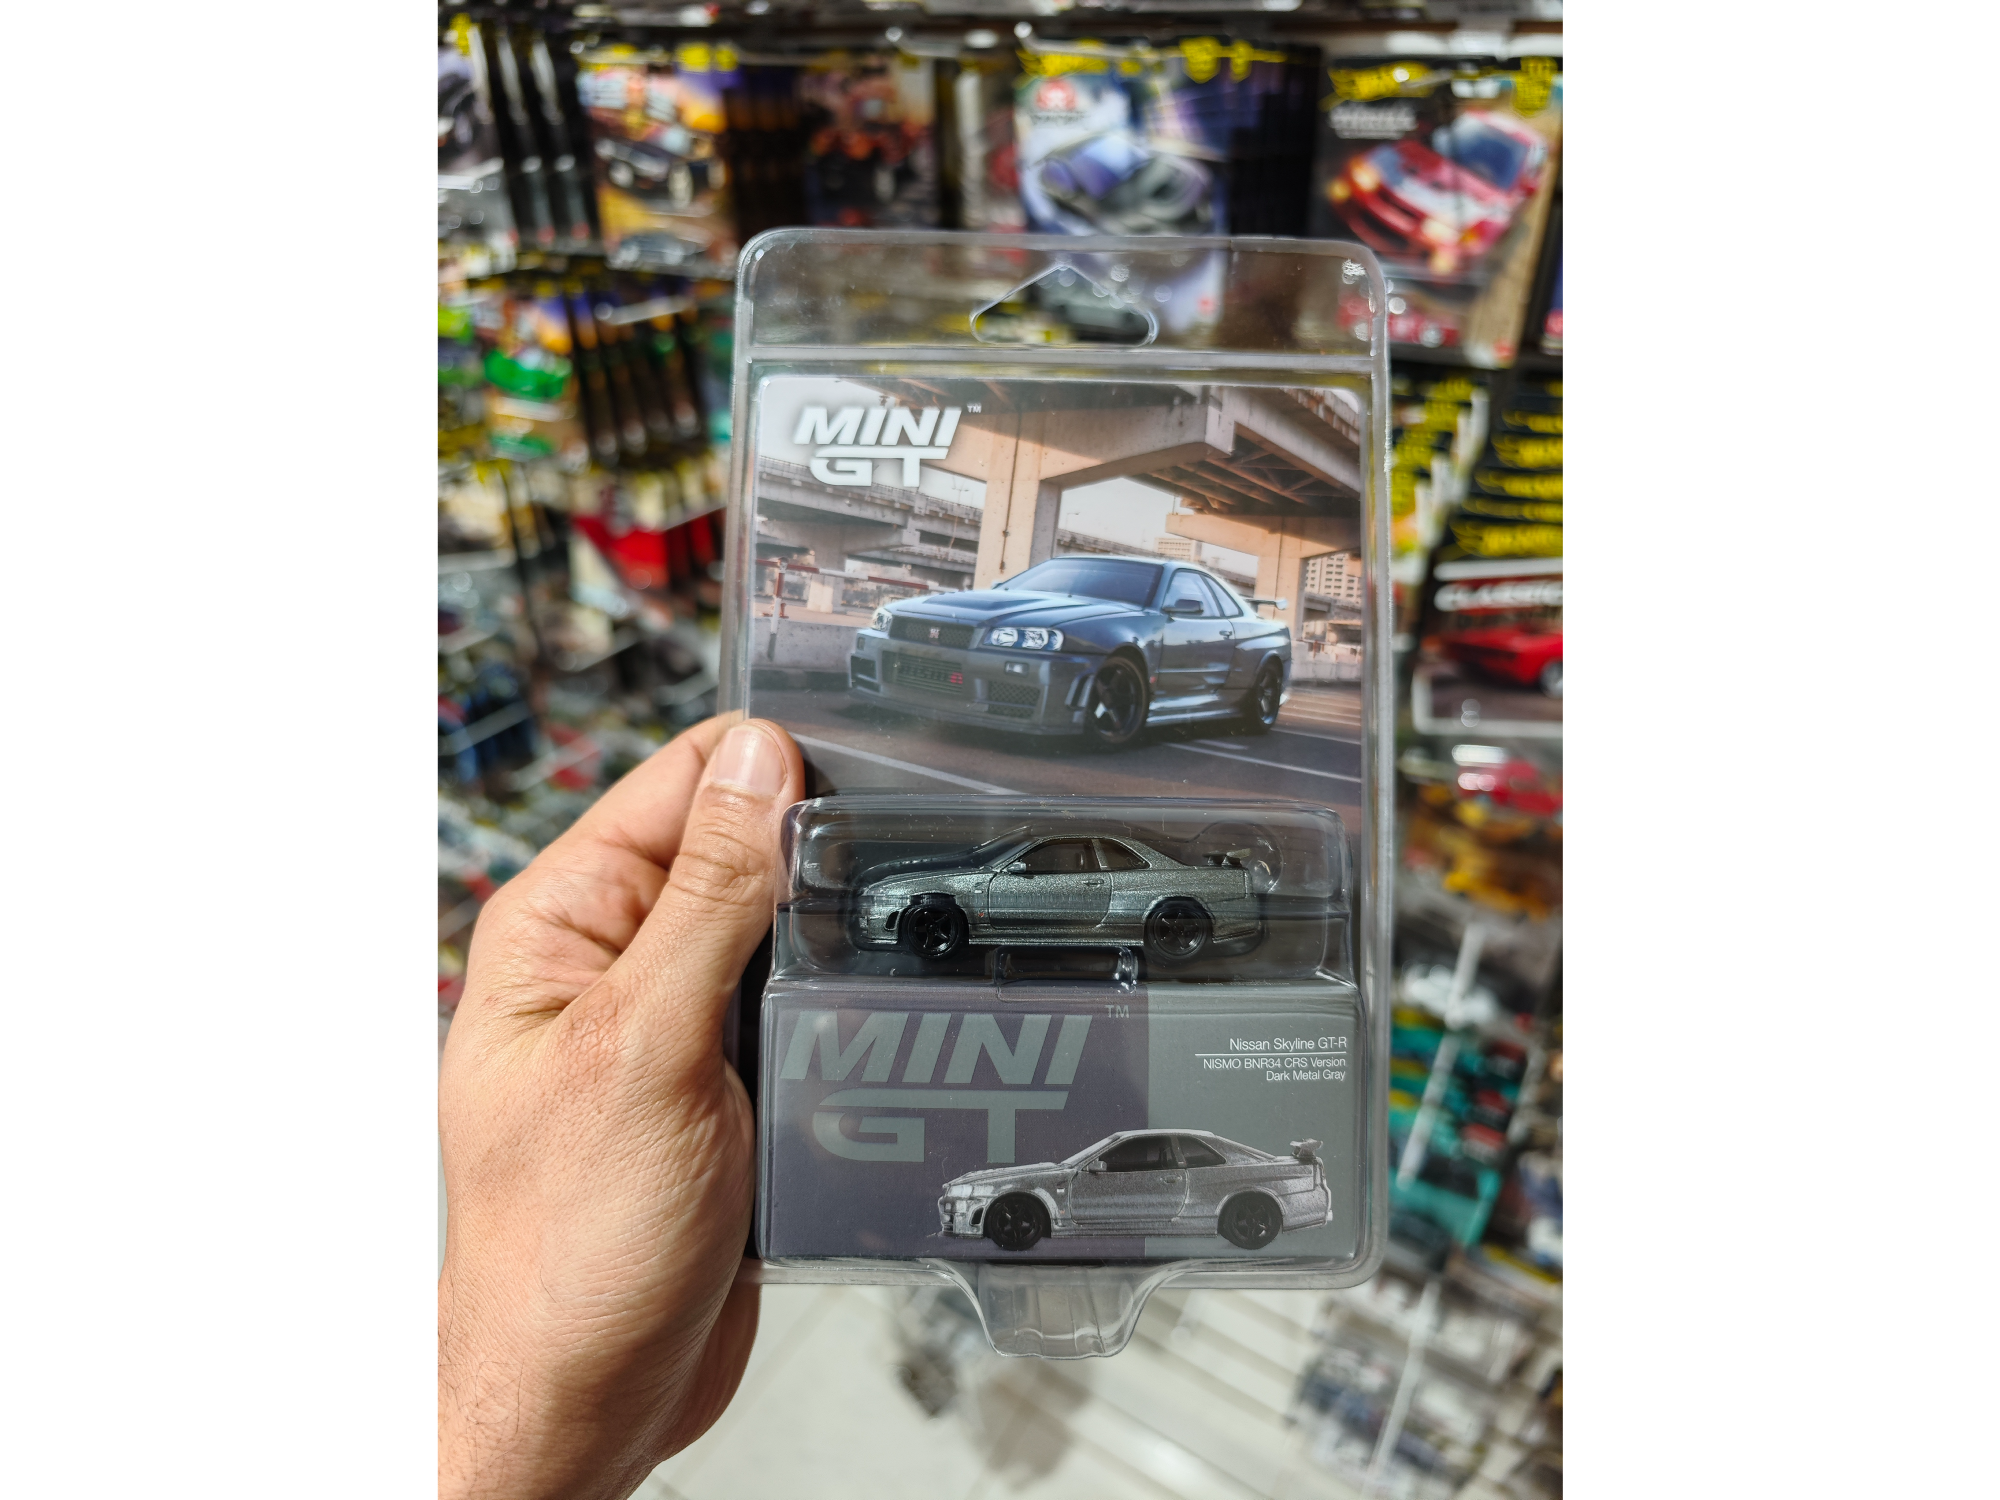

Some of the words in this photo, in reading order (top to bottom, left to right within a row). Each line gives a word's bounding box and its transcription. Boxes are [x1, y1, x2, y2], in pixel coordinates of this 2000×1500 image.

[794, 406, 962, 447] MINI
[809, 446, 949, 488] GT
[779, 1010, 1093, 1085] MINI
[1203, 1058, 1241, 1069] NISMO
[1244, 1058, 1281, 1069] BNR34
[1284, 1057, 1308, 1068] CRS
[1310, 1056, 1346, 1067] Version
[1229, 1038, 1270, 1051] Nissan
[1273, 1037, 1315, 1053] Skyline
[1317, 1036, 1347, 1049] GT-R
[1266, 1070, 1290, 1081] Dark
[1292, 1070, 1320, 1080] Metal
[1322, 1069, 1346, 1082] Gray
[811, 1088, 1070, 1163] GT
